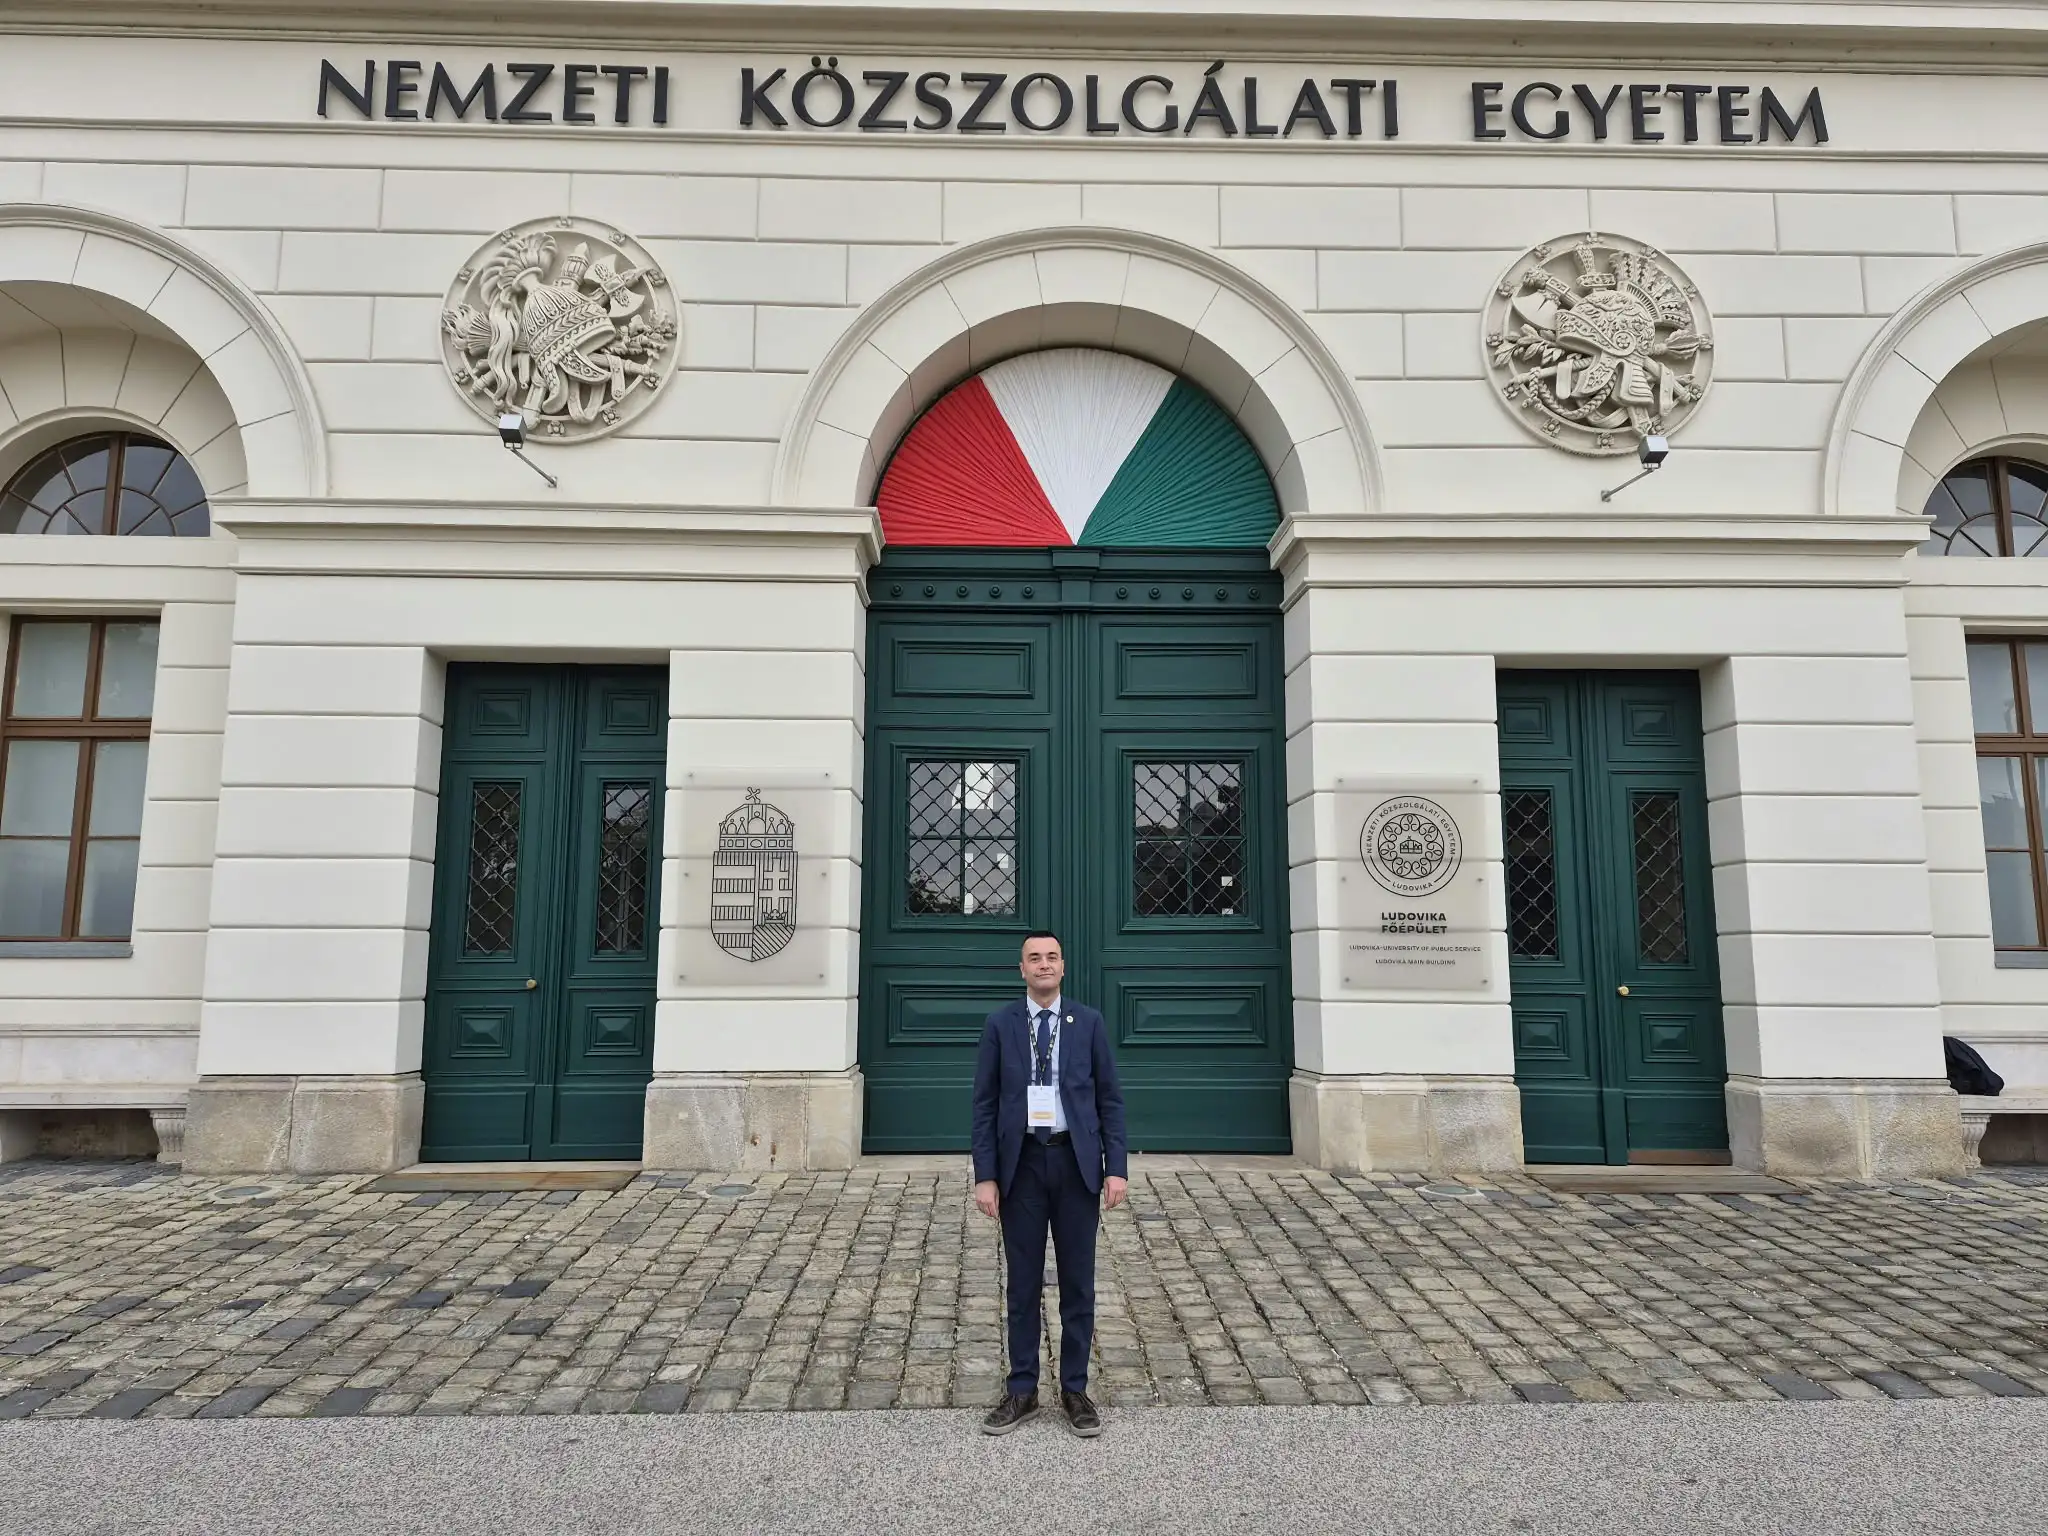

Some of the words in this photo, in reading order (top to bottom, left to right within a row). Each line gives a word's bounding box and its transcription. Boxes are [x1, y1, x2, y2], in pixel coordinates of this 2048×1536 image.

[317, 58, 669, 125] NEMZETI
[740, 55, 1398, 136] KÖZSZOLGÁLATI
[1470, 81, 1828, 143] EGYETEM
[1366, 819, 1380, 854] NEMZETI
[1379, 802, 1440, 819] KÖZSZOLGÁLATI
[1440, 818, 1456, 855] EGYETEM
[1392, 881, 1433, 892] LUDOVIKA
[1381, 912, 1446, 921] LUDOVIKA
[1381, 922, 1447, 933] FŐÉPÜLET
